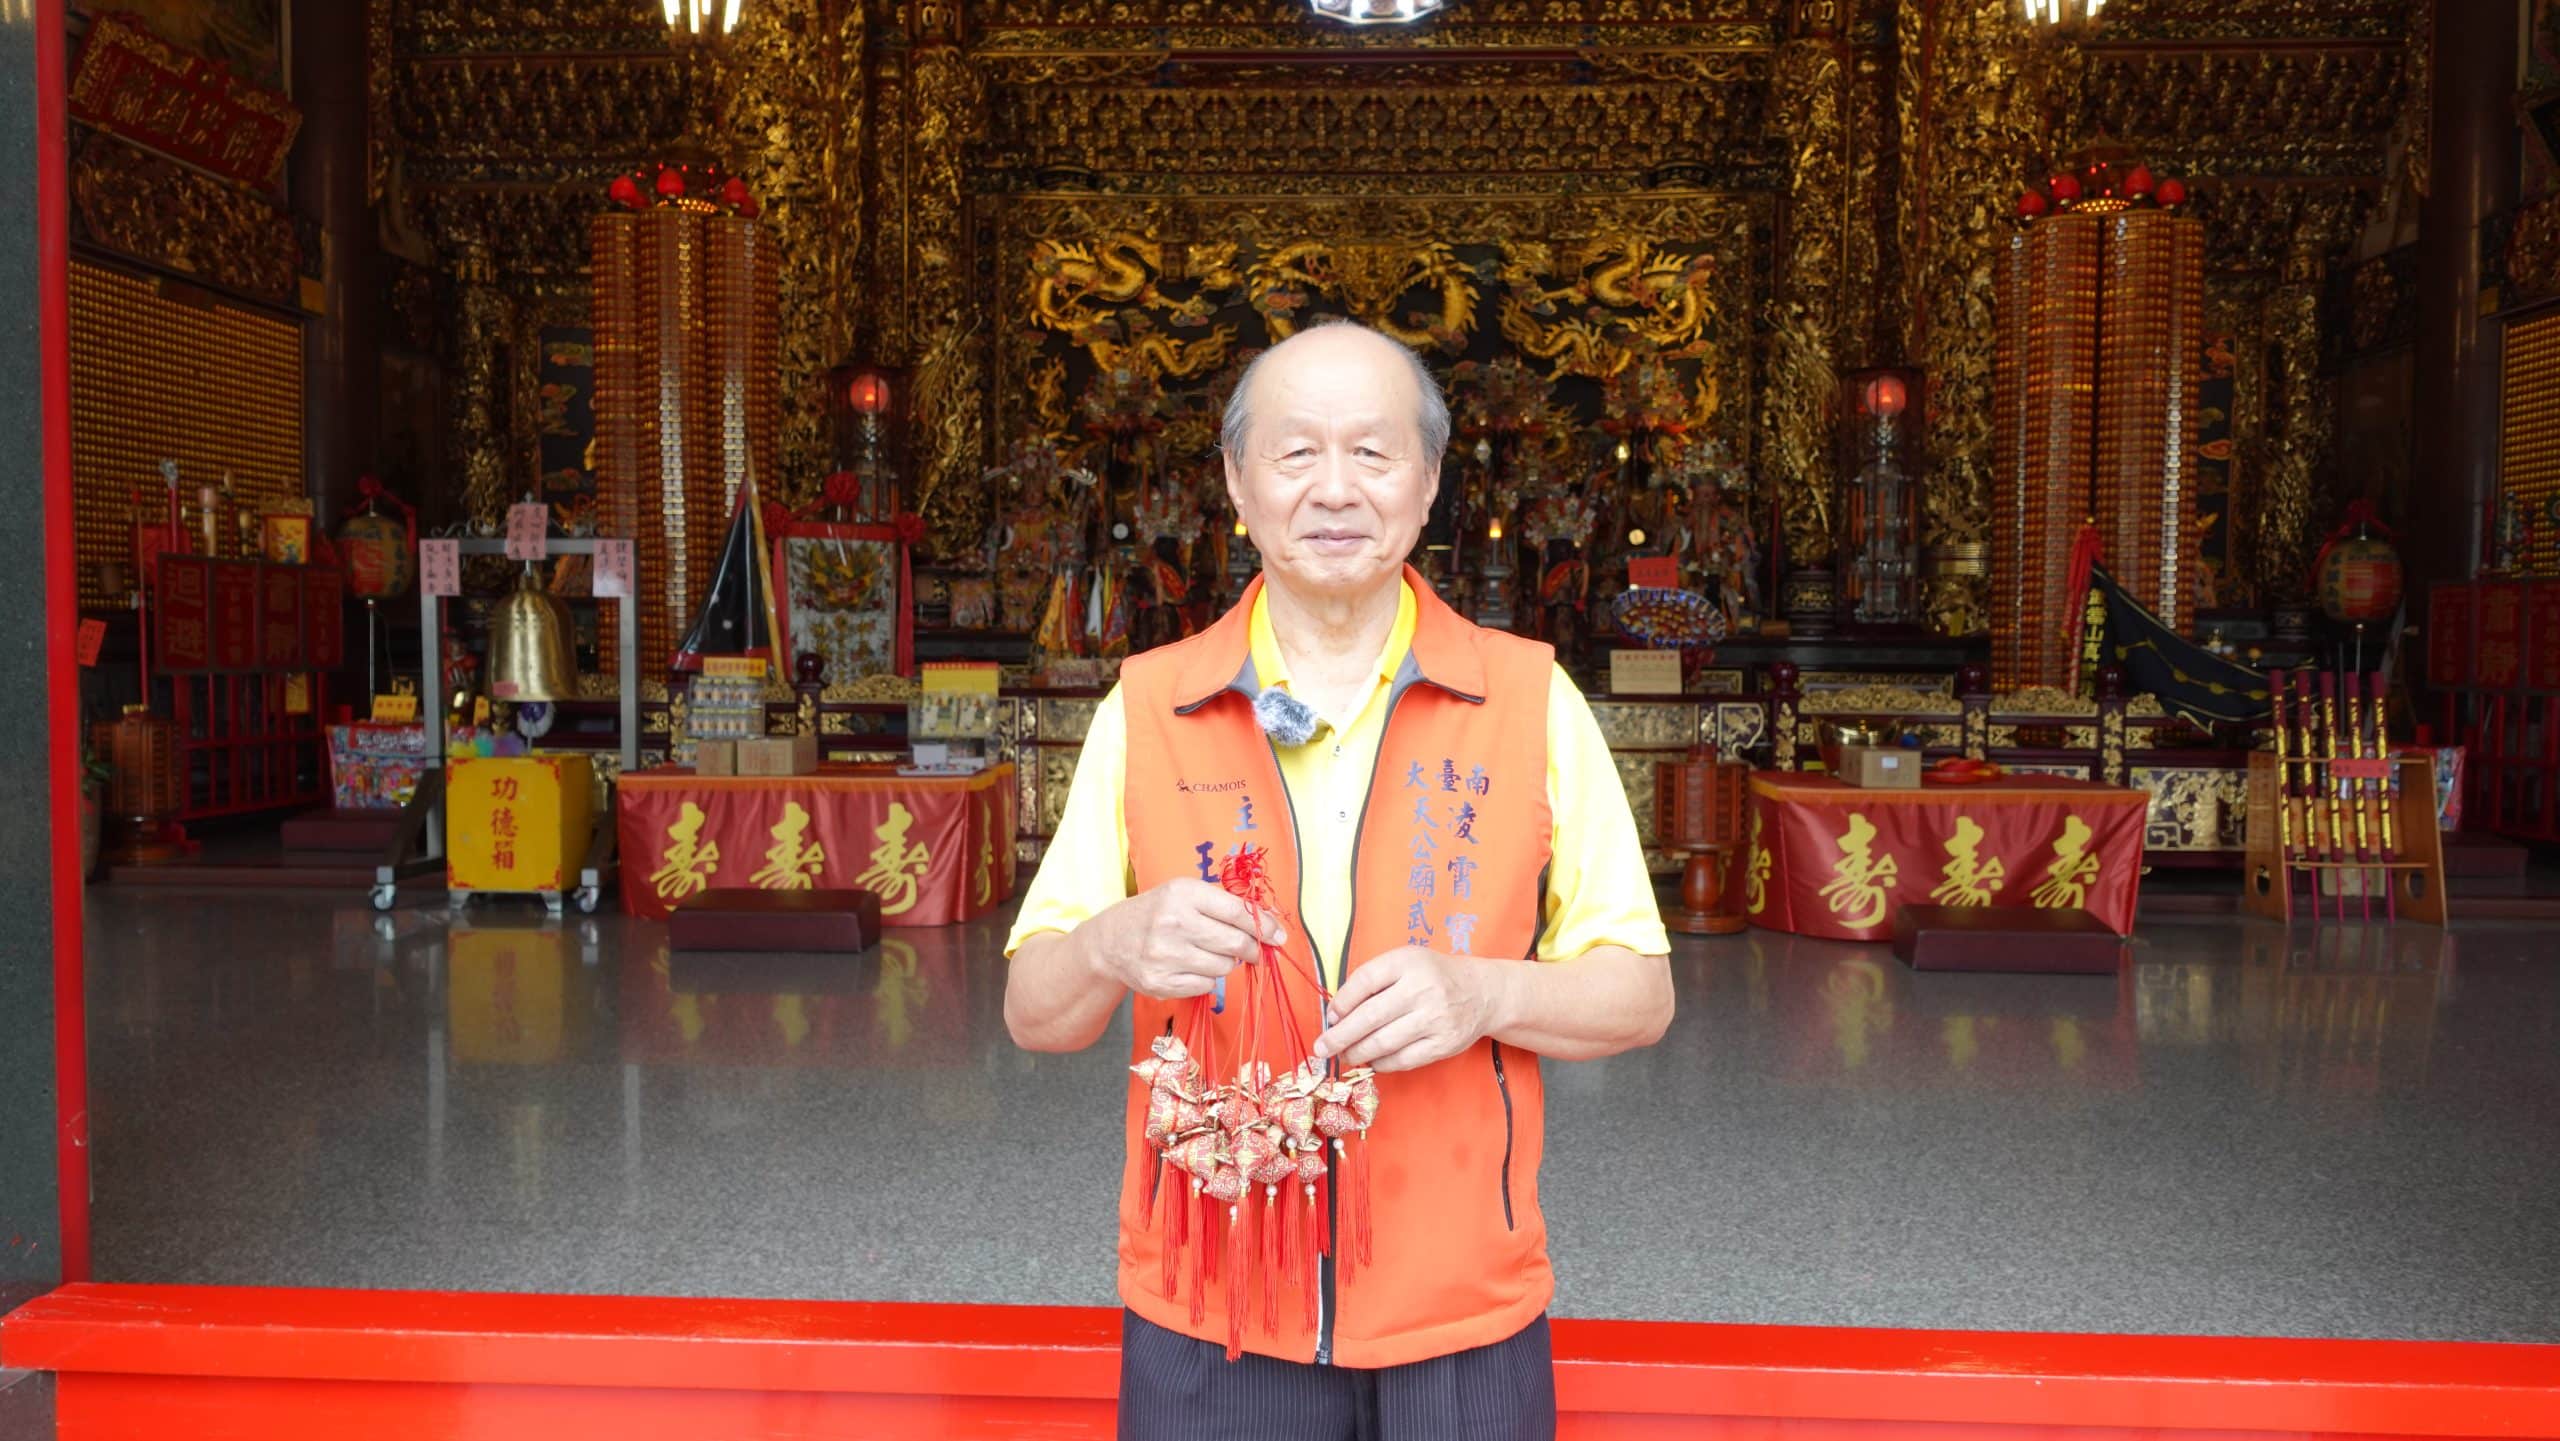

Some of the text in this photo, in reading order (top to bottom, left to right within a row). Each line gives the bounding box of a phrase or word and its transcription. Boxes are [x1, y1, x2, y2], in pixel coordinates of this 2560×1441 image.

[1193, 779, 1247, 793] CHAMOIS
[1436, 757, 1491, 796] 臺南
[489, 776, 518, 871] 功德箱
